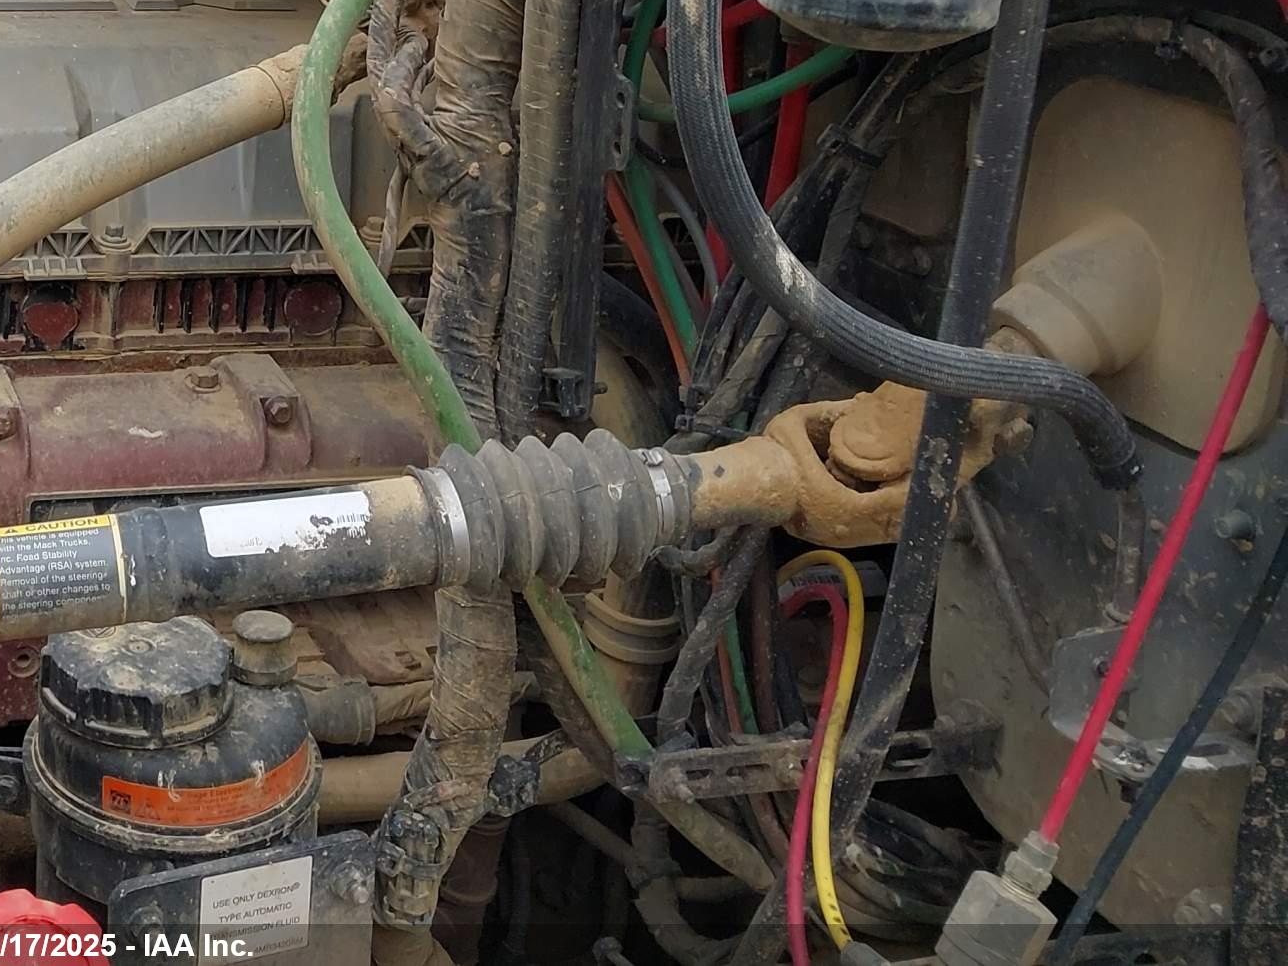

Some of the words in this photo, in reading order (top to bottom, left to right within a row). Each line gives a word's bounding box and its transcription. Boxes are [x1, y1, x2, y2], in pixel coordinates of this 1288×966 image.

[25, 517, 99, 532] CAUTION
[16, 534, 47, 542] vehicle
[58, 527, 99, 538] equipped
[33, 541, 58, 550] Mack
[16, 552, 40, 562] Road
[41, 549, 78, 560] Stability
[0, 564, 46, 576] Advantage
[48, 558, 73, 572] (RSA)
[0, 575, 39, 587] Removal
[40, 574, 50, 584] of
[52, 572, 66, 583] the
[36, 586, 60, 597] other
[61, 584, 99, 594] changes
[100, 582, 111, 591] to
[2, 602, 16, 610] the
[18, 599, 54, 610] steering
[212, 898, 231, 910] USE
[232, 893, 255, 905] ONLY
[219, 913, 242, 923] TYPE
[243, 901, 292, 919] AUTOMATIC
[275, 916, 301, 929] FLUID
